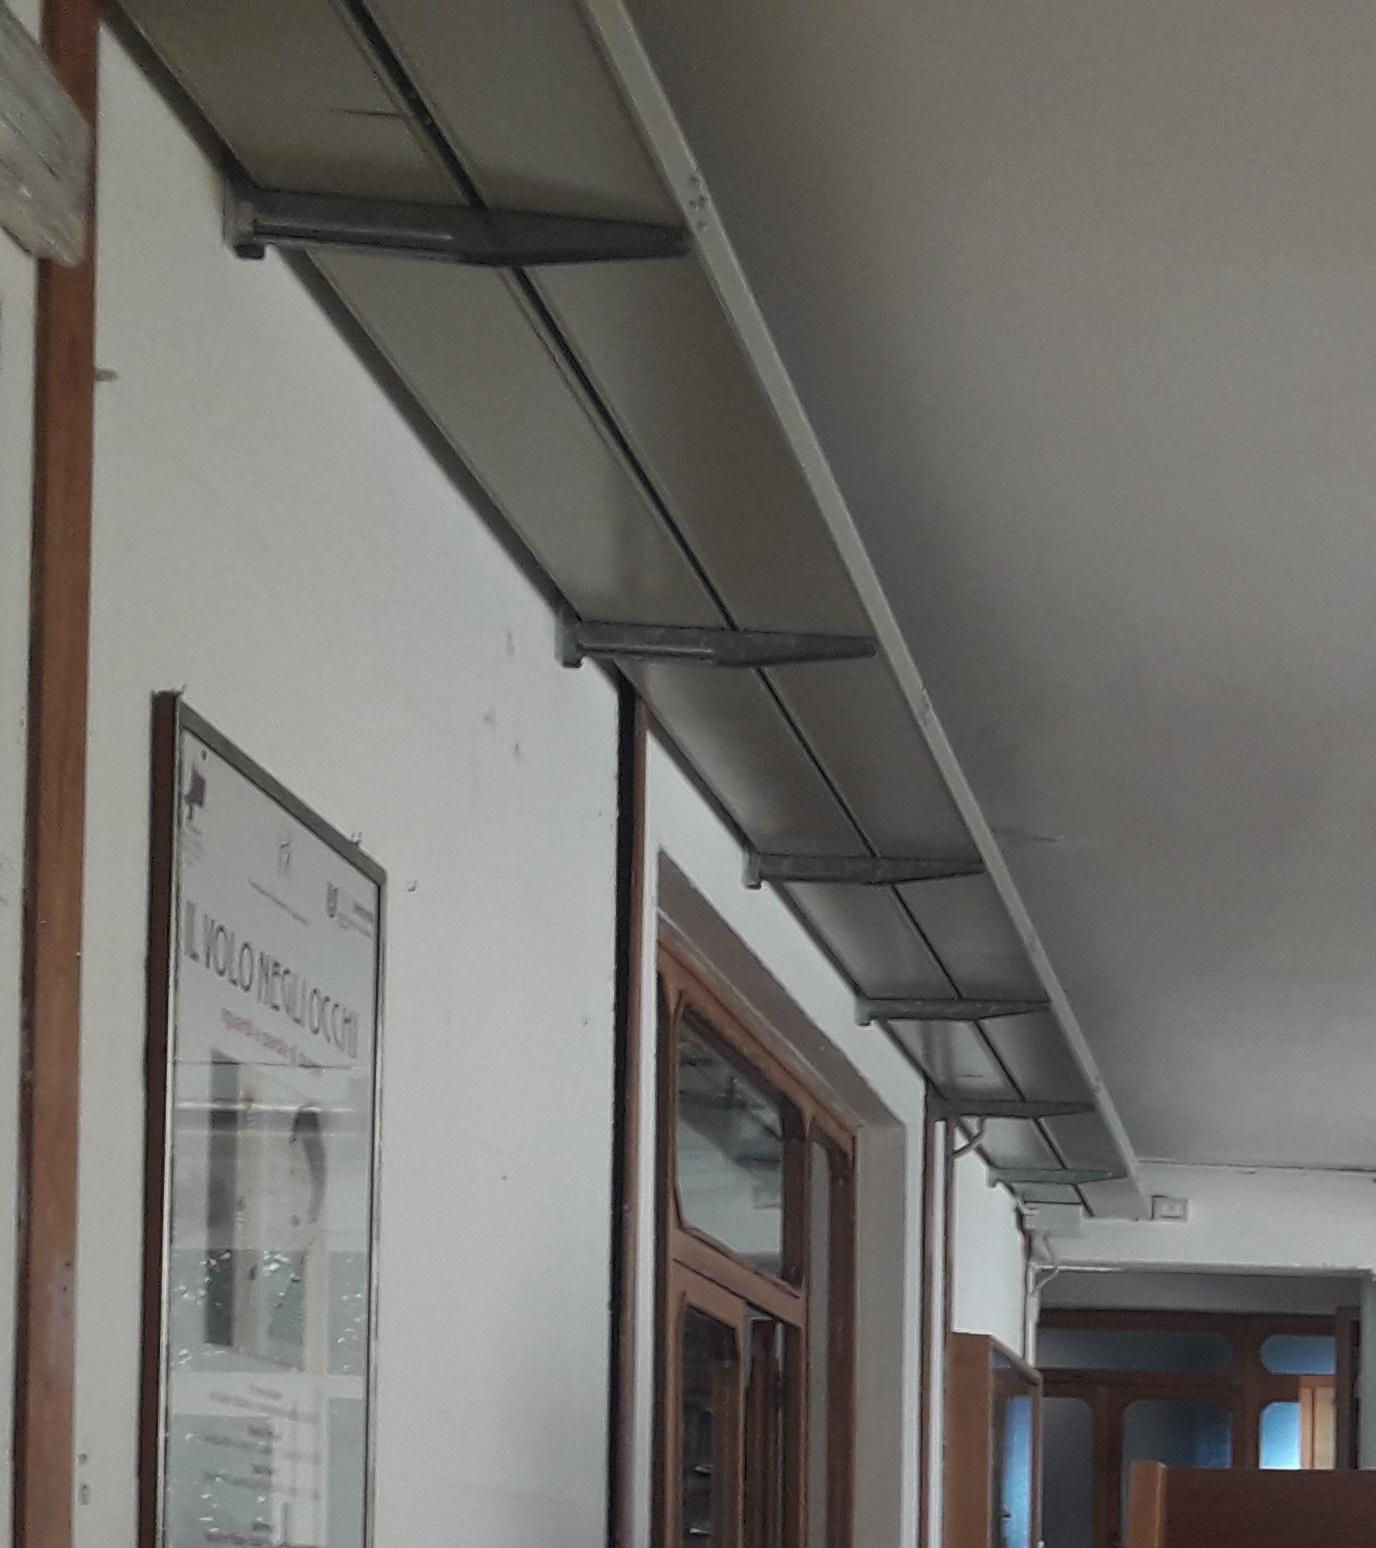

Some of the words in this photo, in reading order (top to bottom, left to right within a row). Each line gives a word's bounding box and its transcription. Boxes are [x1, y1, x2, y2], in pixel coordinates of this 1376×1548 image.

[204, 913, 254, 992] VOLO
[257, 951, 306, 1029] NEGLI
[308, 987, 360, 1060] OCCHI
